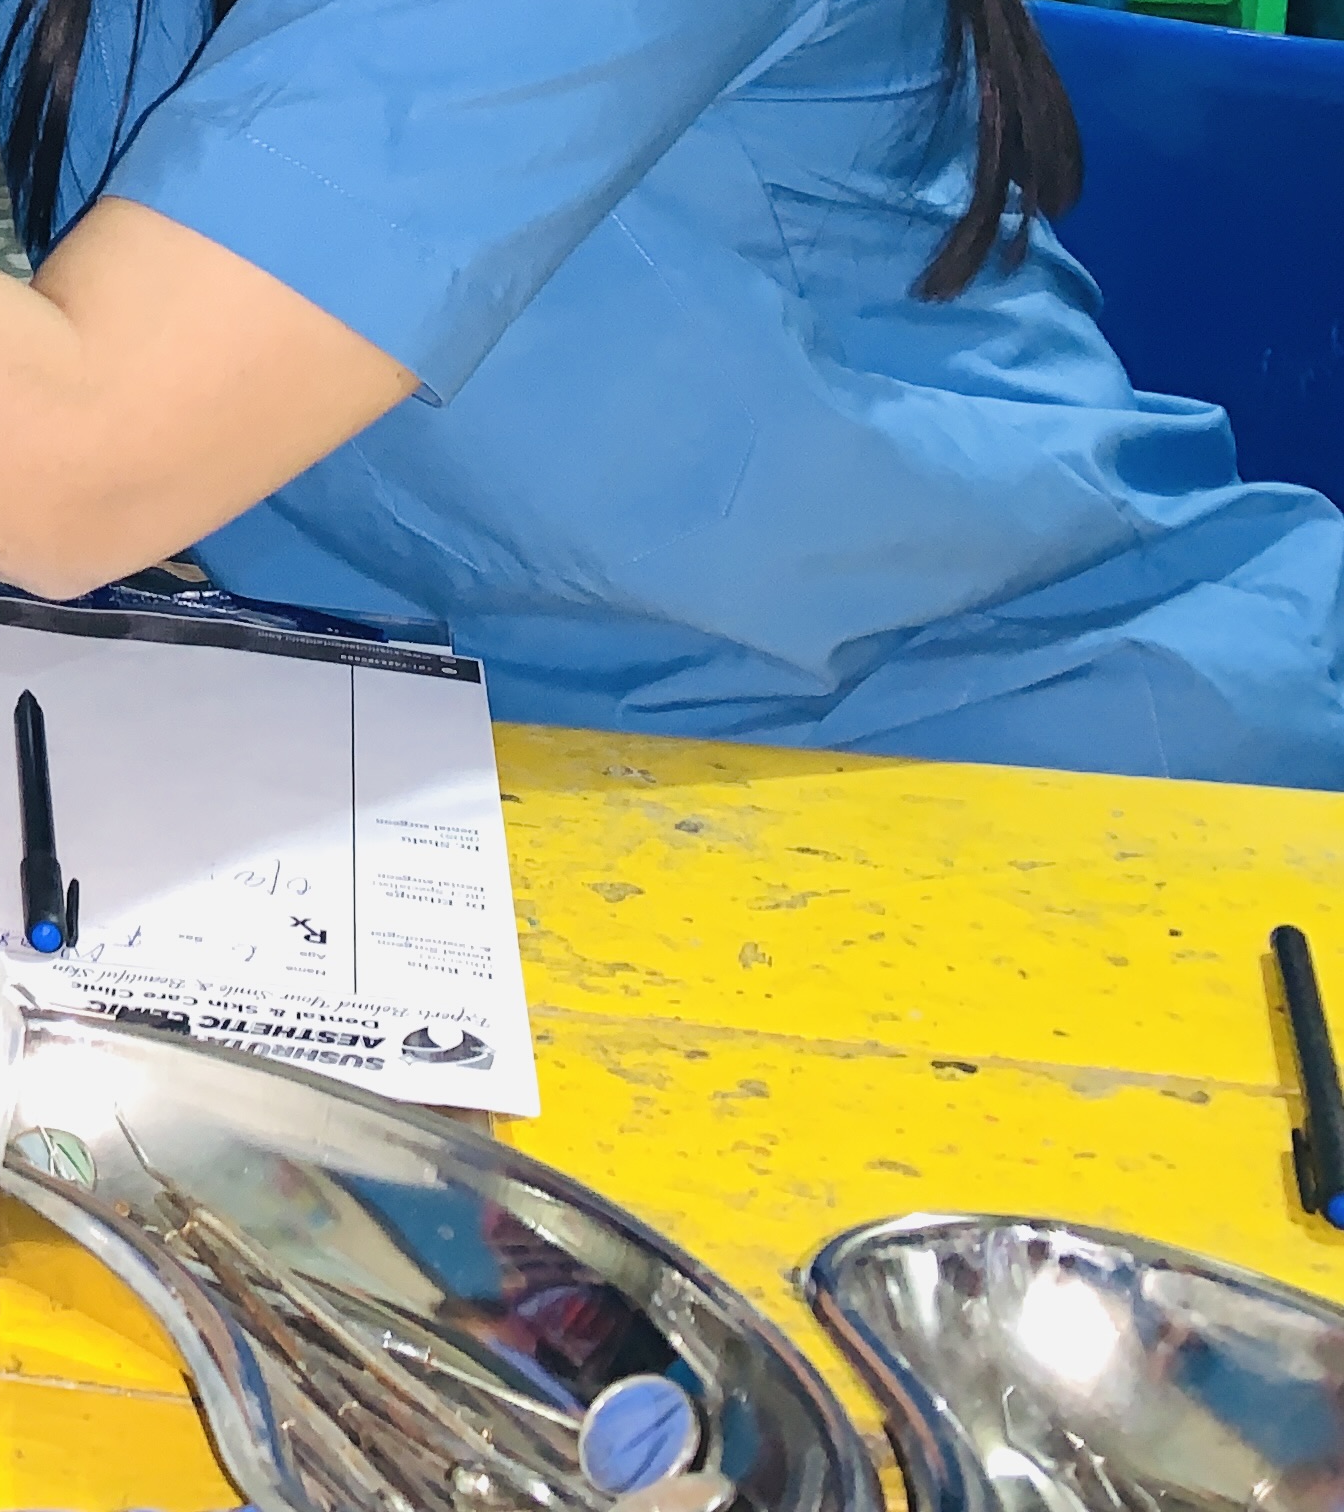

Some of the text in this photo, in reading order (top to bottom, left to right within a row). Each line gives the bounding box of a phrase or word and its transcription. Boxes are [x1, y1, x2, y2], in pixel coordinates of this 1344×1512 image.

[143, 991, 199, 1007] Care
[208, 998, 258, 1015] Skin
[296, 1011, 380, 1029] Dental
[198, 1014, 387, 1049] AESTHETIC
